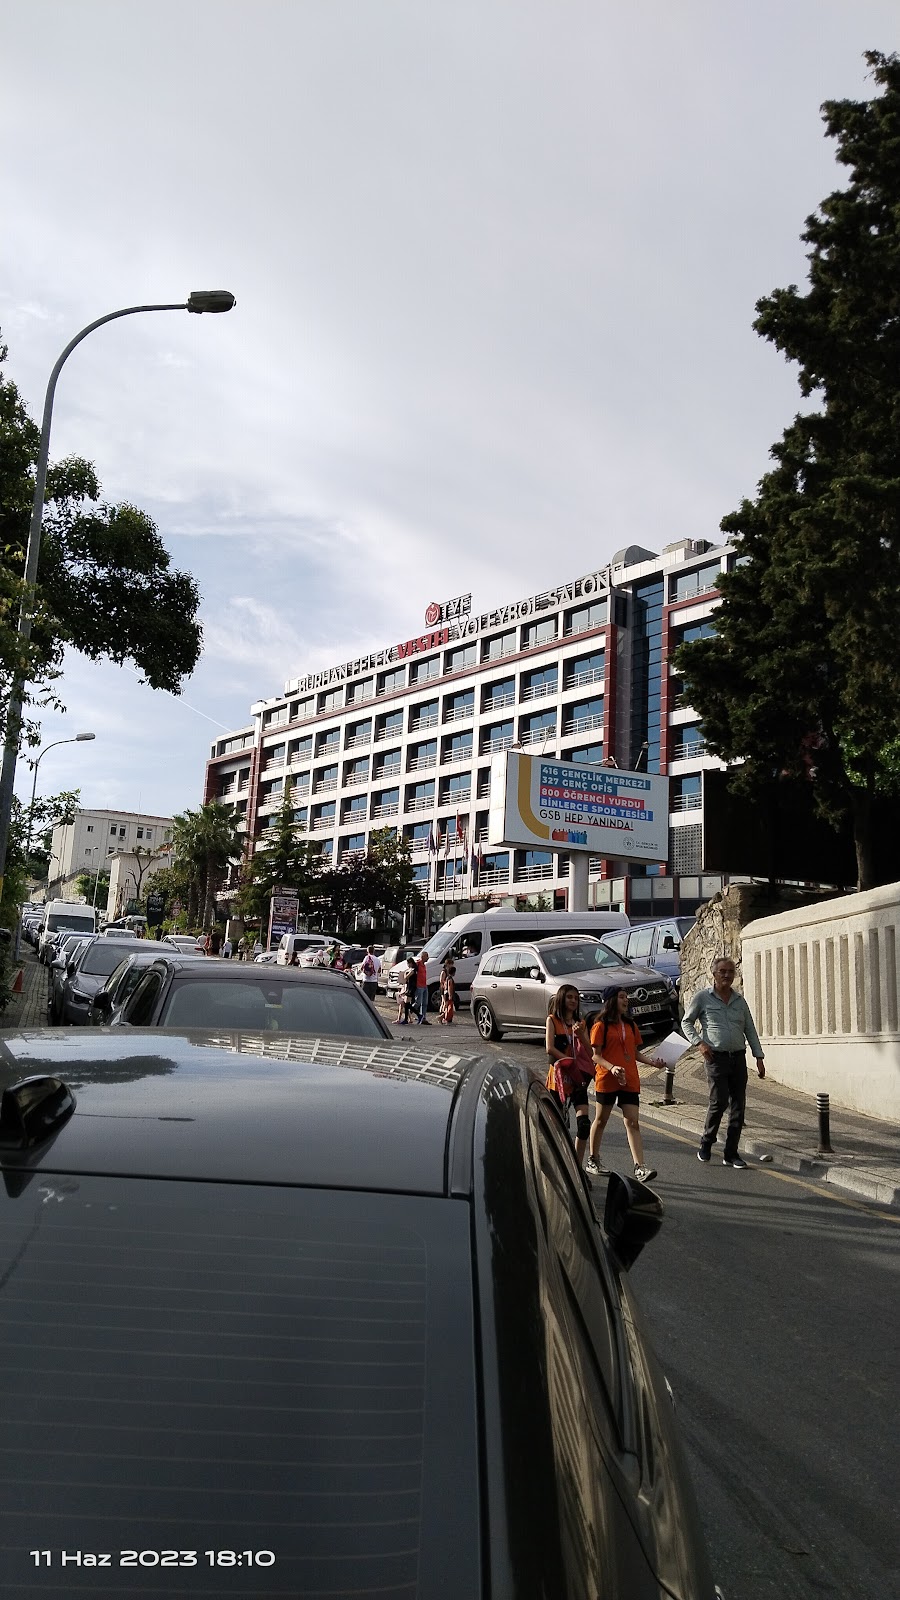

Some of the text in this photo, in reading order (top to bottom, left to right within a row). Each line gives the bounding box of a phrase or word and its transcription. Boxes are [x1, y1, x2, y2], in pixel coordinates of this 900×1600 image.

[441, 595, 471, 619] TVF
[397, 627, 449, 659] VESTEL
[541, 776, 613, 793] 327 GENÇ OFİS
[542, 766, 647, 789] 416 GENÇLİK MERKEZİ
[541, 788, 641, 809] 800 ÖĞRENCİ YURDU
[541, 797, 649, 820] BİNLERCE SPOR TESİSİ
[539, 809, 561, 821] GSB
[564, 812, 584, 824] HEP
